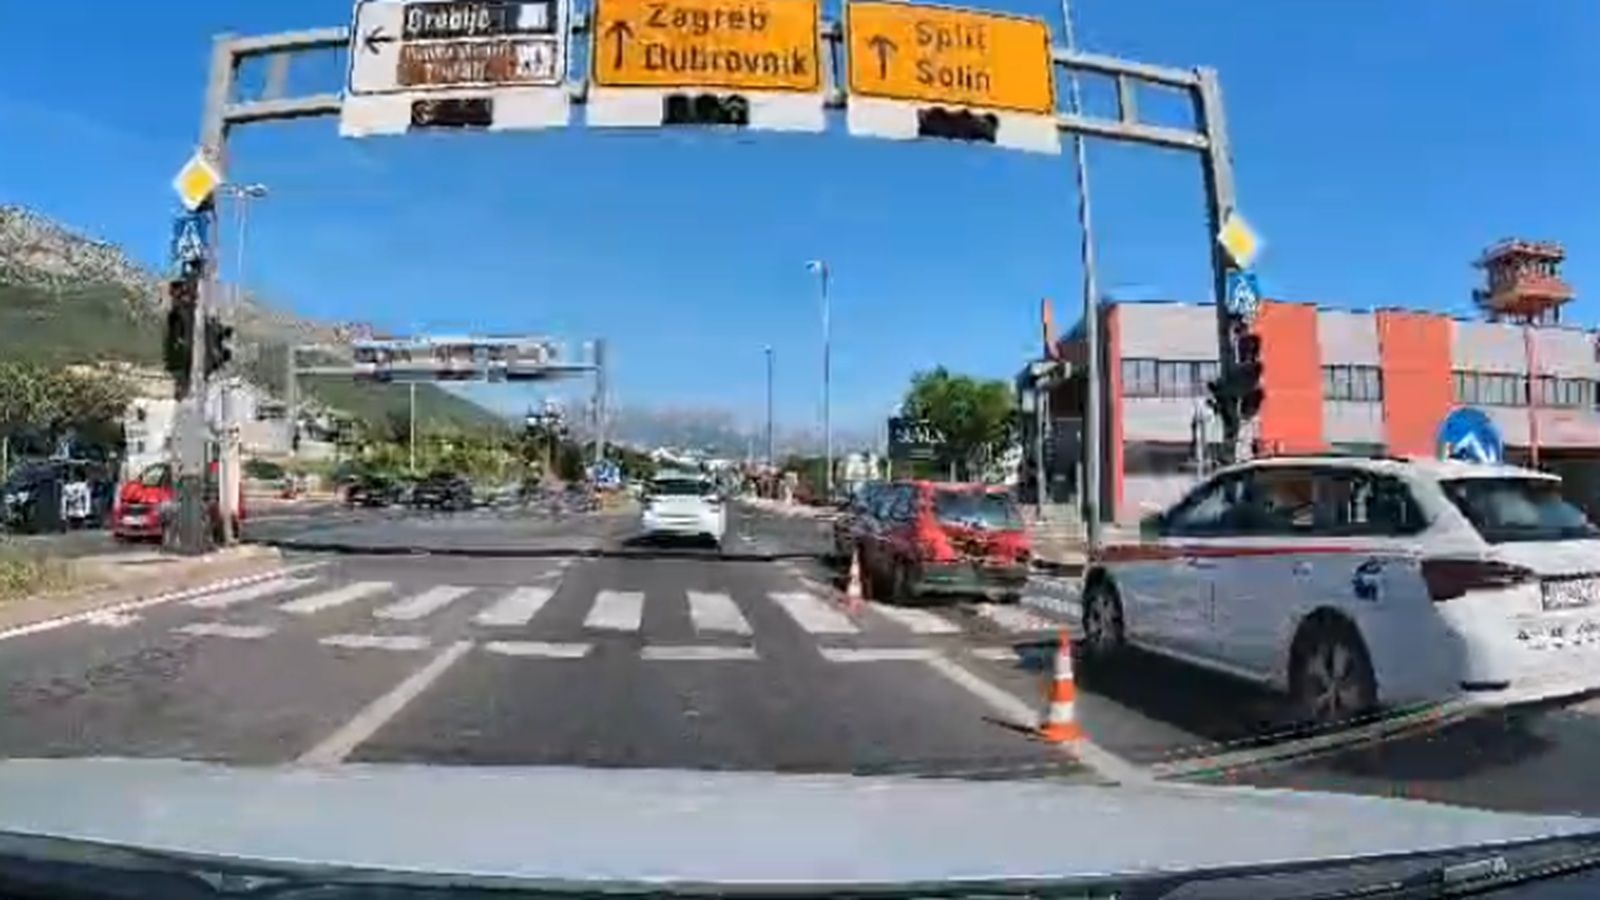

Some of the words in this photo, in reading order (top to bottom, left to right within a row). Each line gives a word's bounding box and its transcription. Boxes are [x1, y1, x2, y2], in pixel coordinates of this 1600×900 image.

[646, 3, 767, 36] Zagreb
[915, 20, 987, 53] Split
[643, 44, 808, 75] Dubrovnik
[915, 59, 991, 95] Solin
